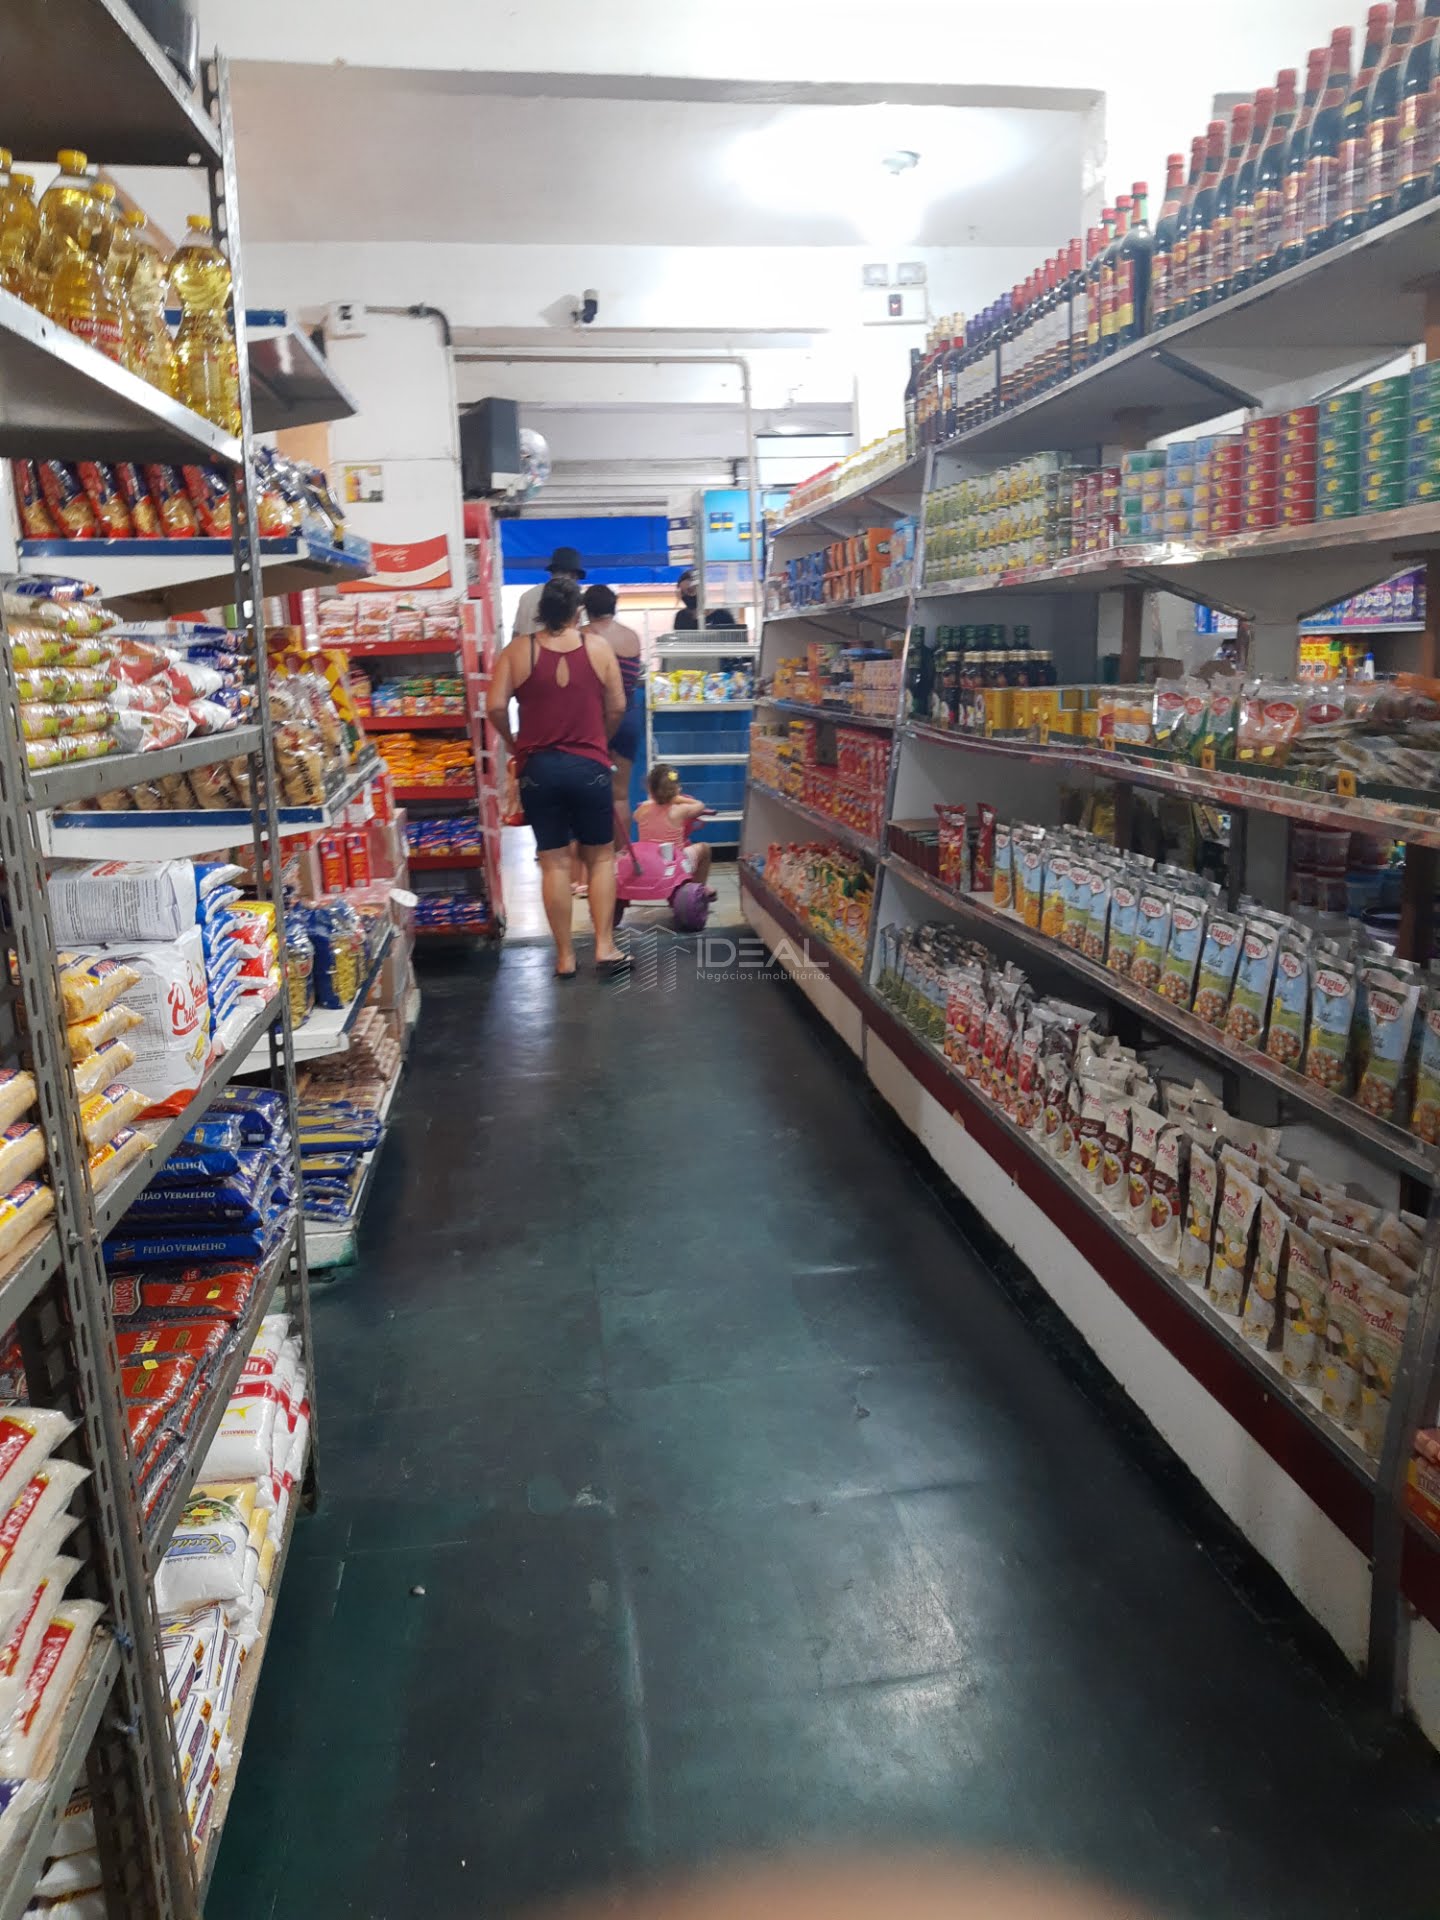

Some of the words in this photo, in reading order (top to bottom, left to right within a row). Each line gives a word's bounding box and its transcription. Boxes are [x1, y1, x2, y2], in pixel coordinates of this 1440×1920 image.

[1211, 924, 1233, 942] Fugini
[1316, 973, 1346, 993] Fugini
[1370, 994, 1400, 1018] Fugini
[163, 1191, 215, 1200] VERMELHO
[143, 1244, 174, 1254] FEIJÃO
[175, 1242, 226, 1252] VERMELHO
[167, 1284, 186, 1304] FEIJÃO
